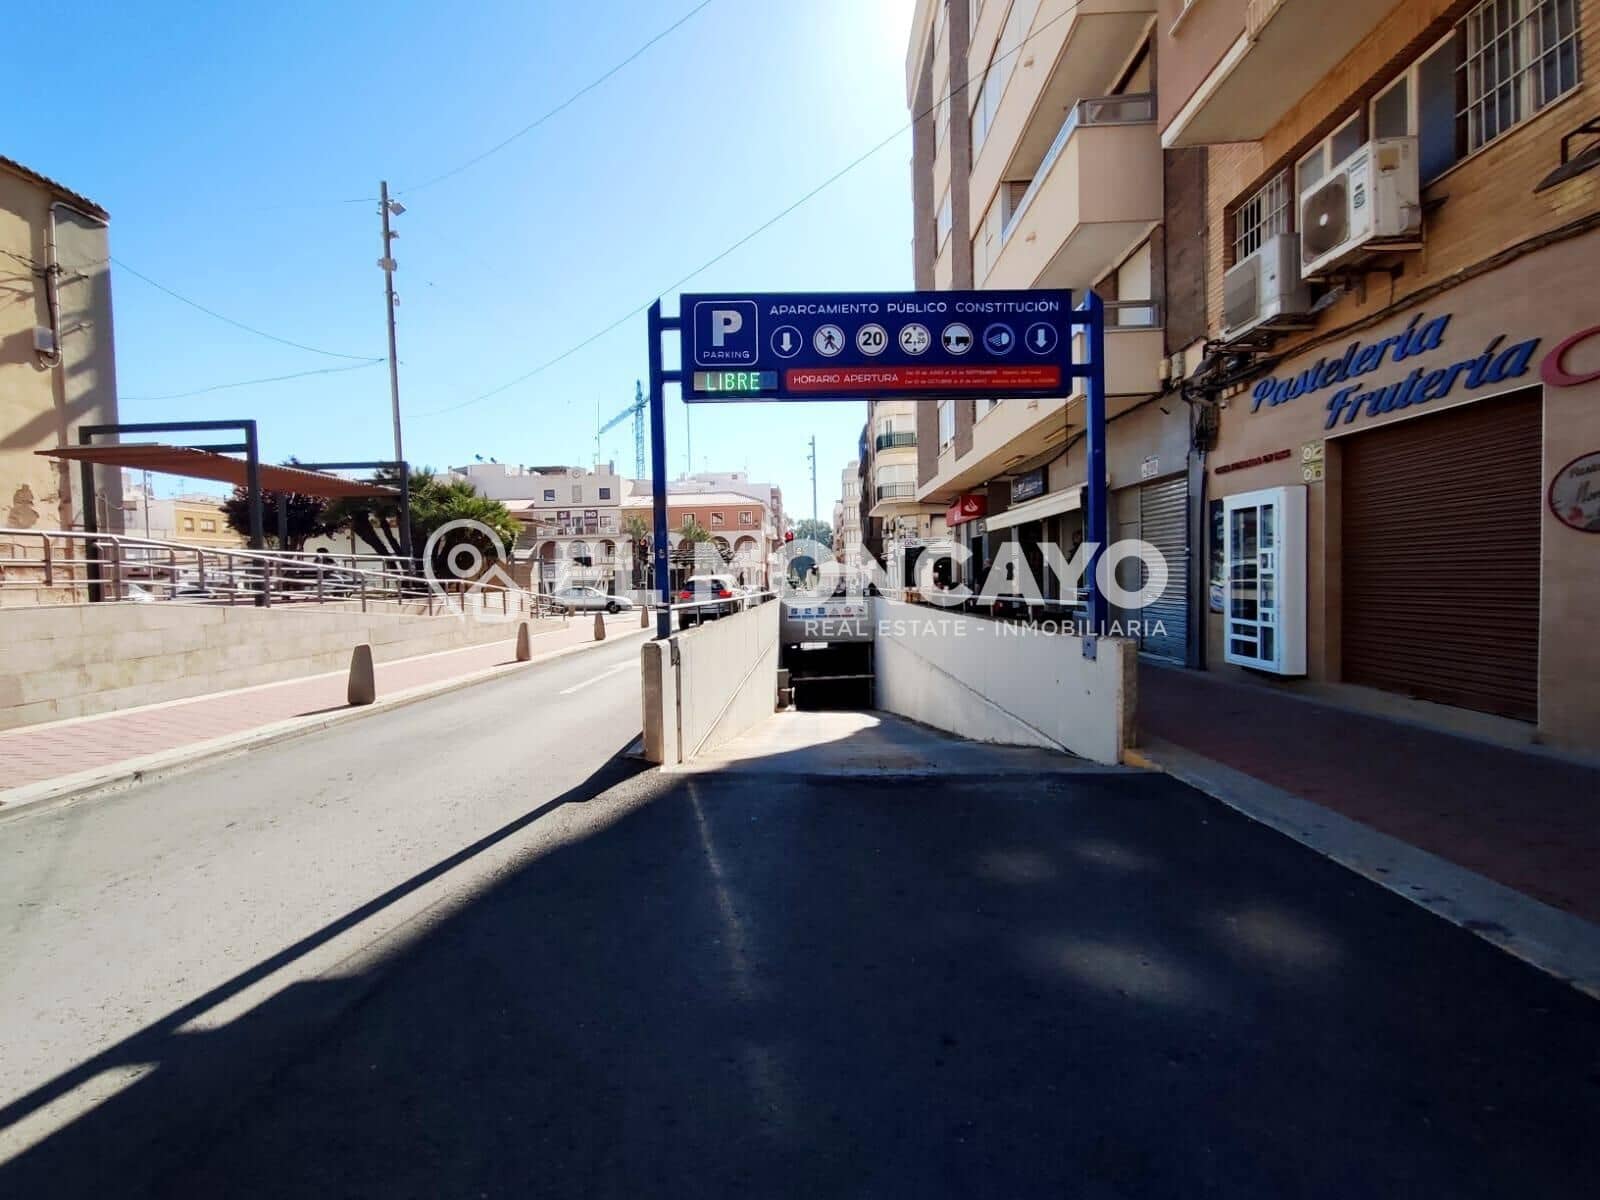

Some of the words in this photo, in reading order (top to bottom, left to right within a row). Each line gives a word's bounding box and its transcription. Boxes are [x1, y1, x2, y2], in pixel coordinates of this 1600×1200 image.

[769, 303, 879, 316] APARCAMIENTO
[887, 300, 947, 313] PÚBLICO
[955, 299, 1059, 313] CONSTITUCIÓN
[712, 310, 743, 347] P
[862, 331, 883, 346] 20
[703, 350, 750, 359] PARKING
[1251, 313, 1453, 414] Pastelería
[706, 371, 761, 391] LIBRE
[793, 375, 840, 385] HORARIO
[843, 373, 899, 383] APERTURA
[1324, 334, 1542, 430] Frutería
